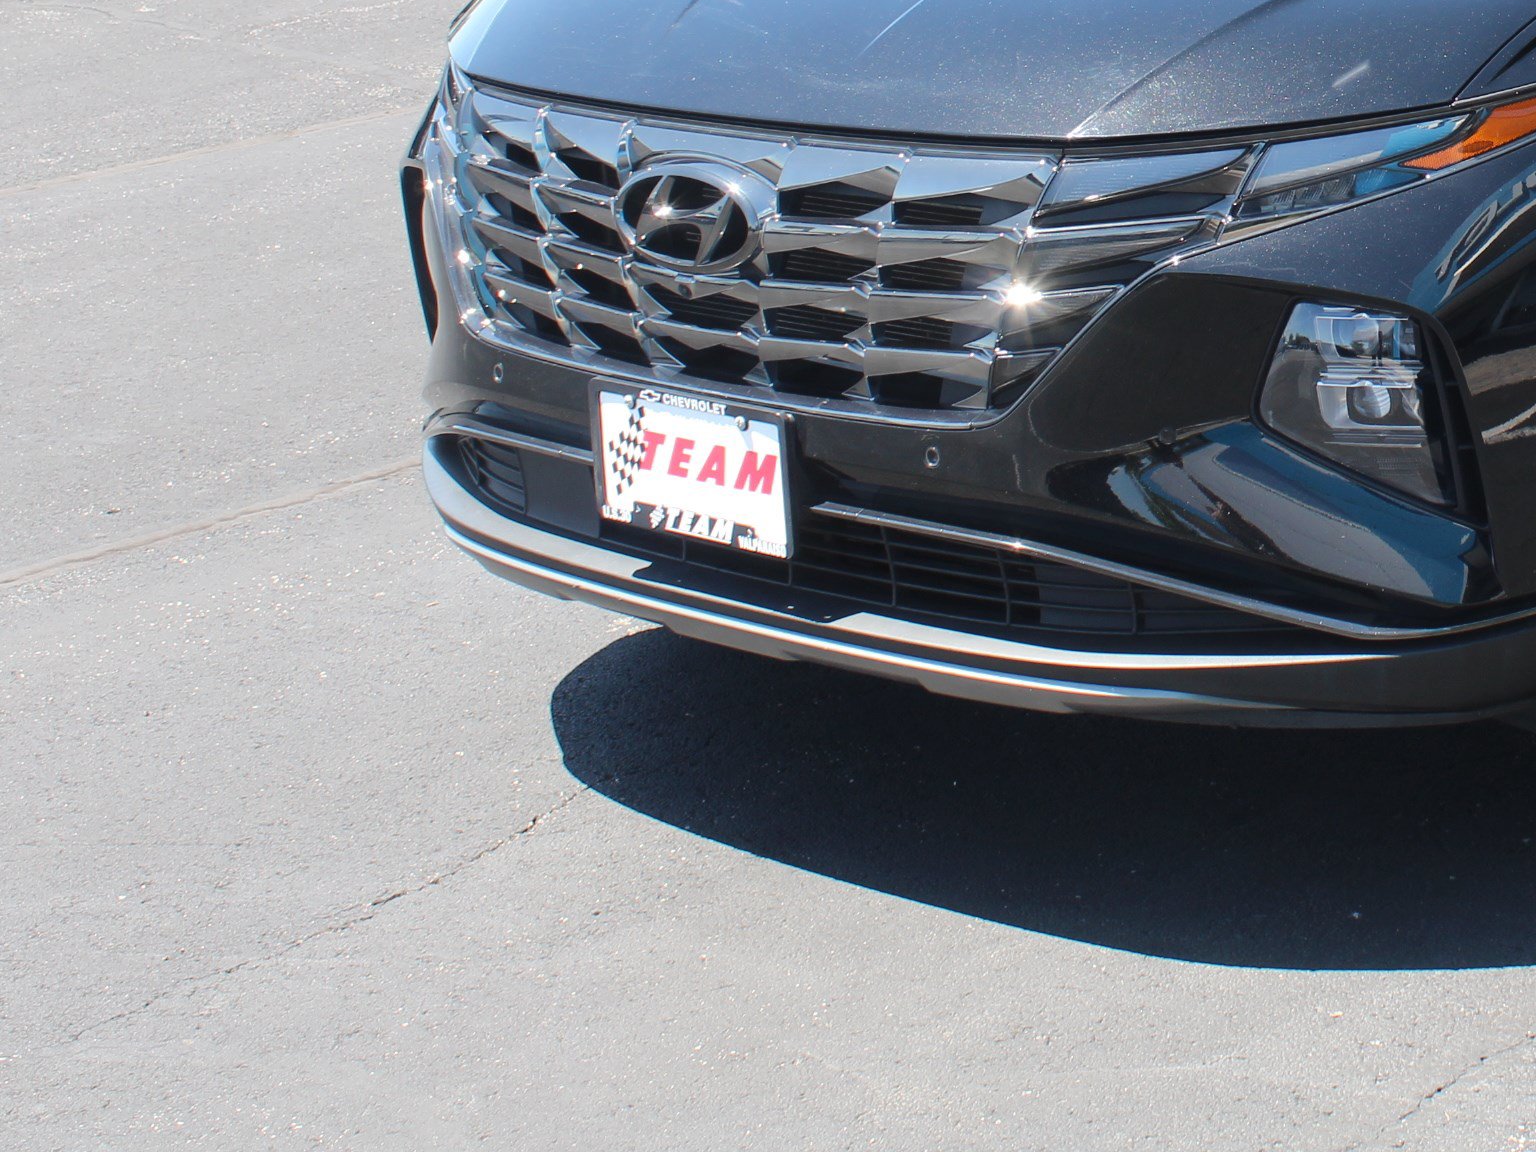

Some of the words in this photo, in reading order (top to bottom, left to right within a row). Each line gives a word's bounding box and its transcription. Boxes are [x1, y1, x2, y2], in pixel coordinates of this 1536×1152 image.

[662, 393, 727, 416] CHEVROLET
[640, 430, 778, 495] TEAM
[665, 507, 735, 545] TEAM
